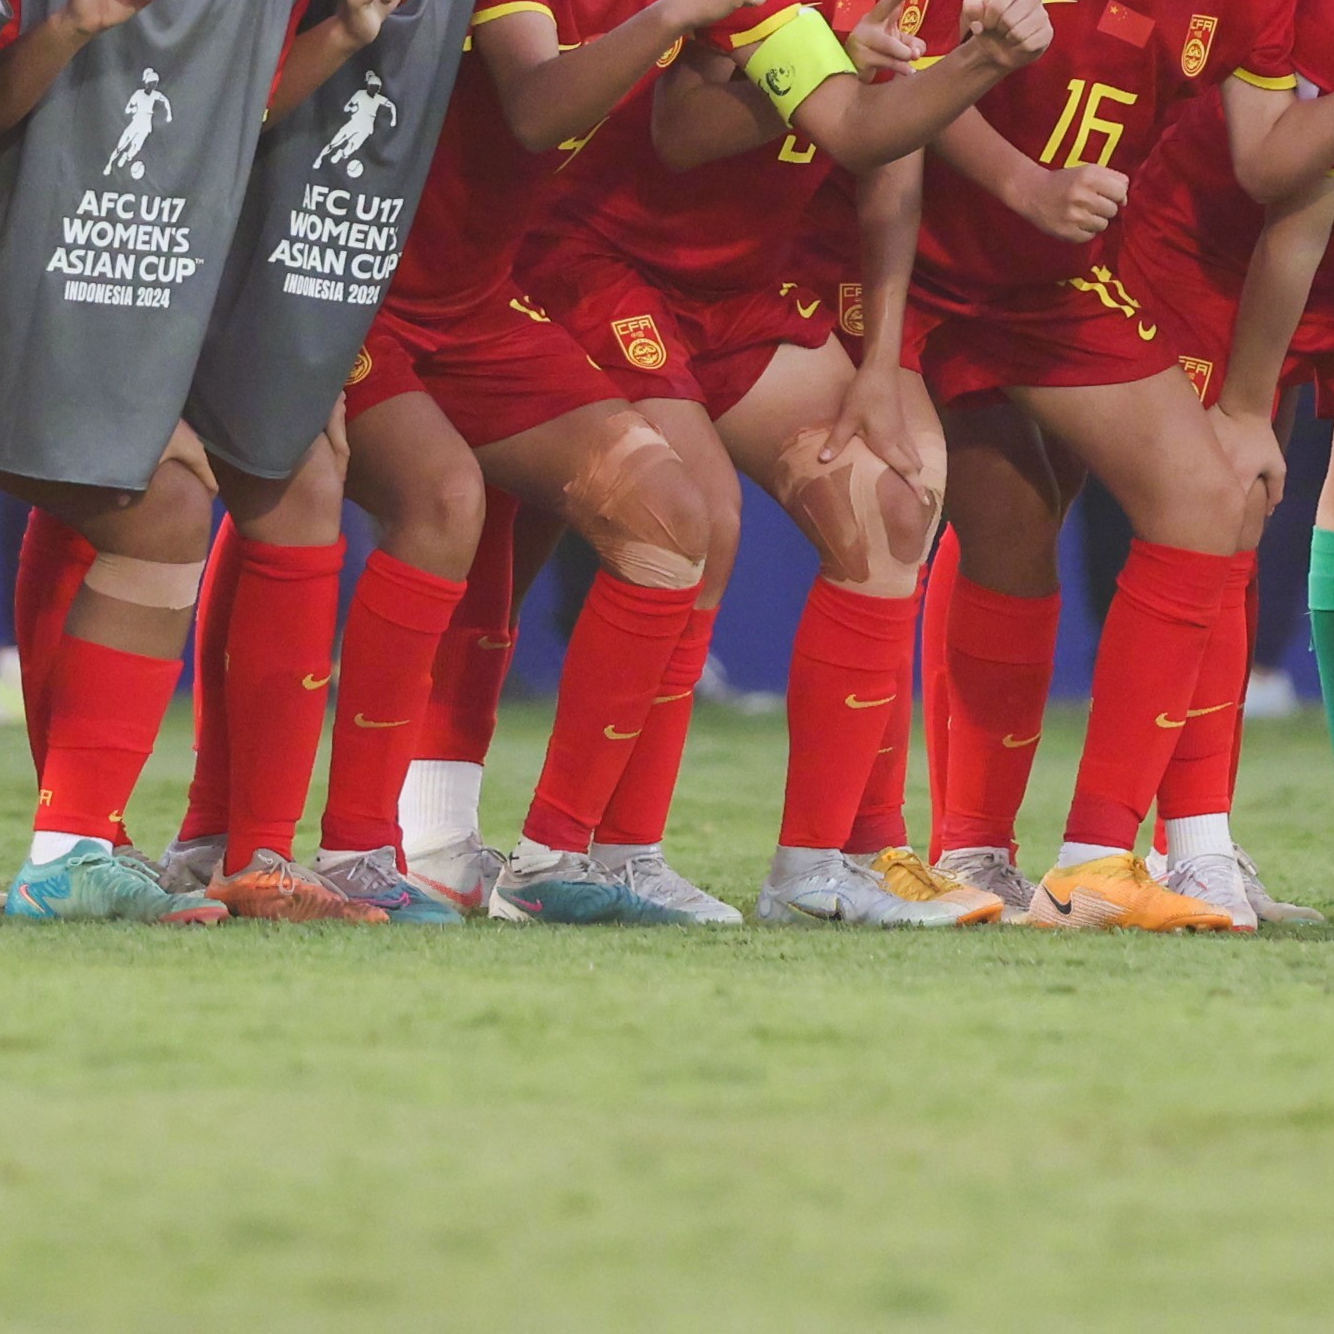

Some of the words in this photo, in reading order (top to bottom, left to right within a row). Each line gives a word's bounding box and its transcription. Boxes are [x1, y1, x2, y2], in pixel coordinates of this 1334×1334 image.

[1190, 18, 1214, 32] CFA
[1039, 78, 1139, 169] 16
[75, 189, 136, 219] AFC
[140, 195, 187, 223] U17
[303, 183, 351, 216] AFC
[355, 194, 404, 223] U17
[62, 217, 191, 253] WOMEN'S
[46, 246, 136, 280] ASIAN
[267, 239, 348, 276] ASIAN
[63, 280, 133, 306] INDONESIA
[135, 286, 171, 308] 2024
[283, 272, 344, 302] INDONESIA
[347, 283, 381, 305] 2024
[843, 286, 863, 298] CF
[617, 319, 651, 336] CFA
